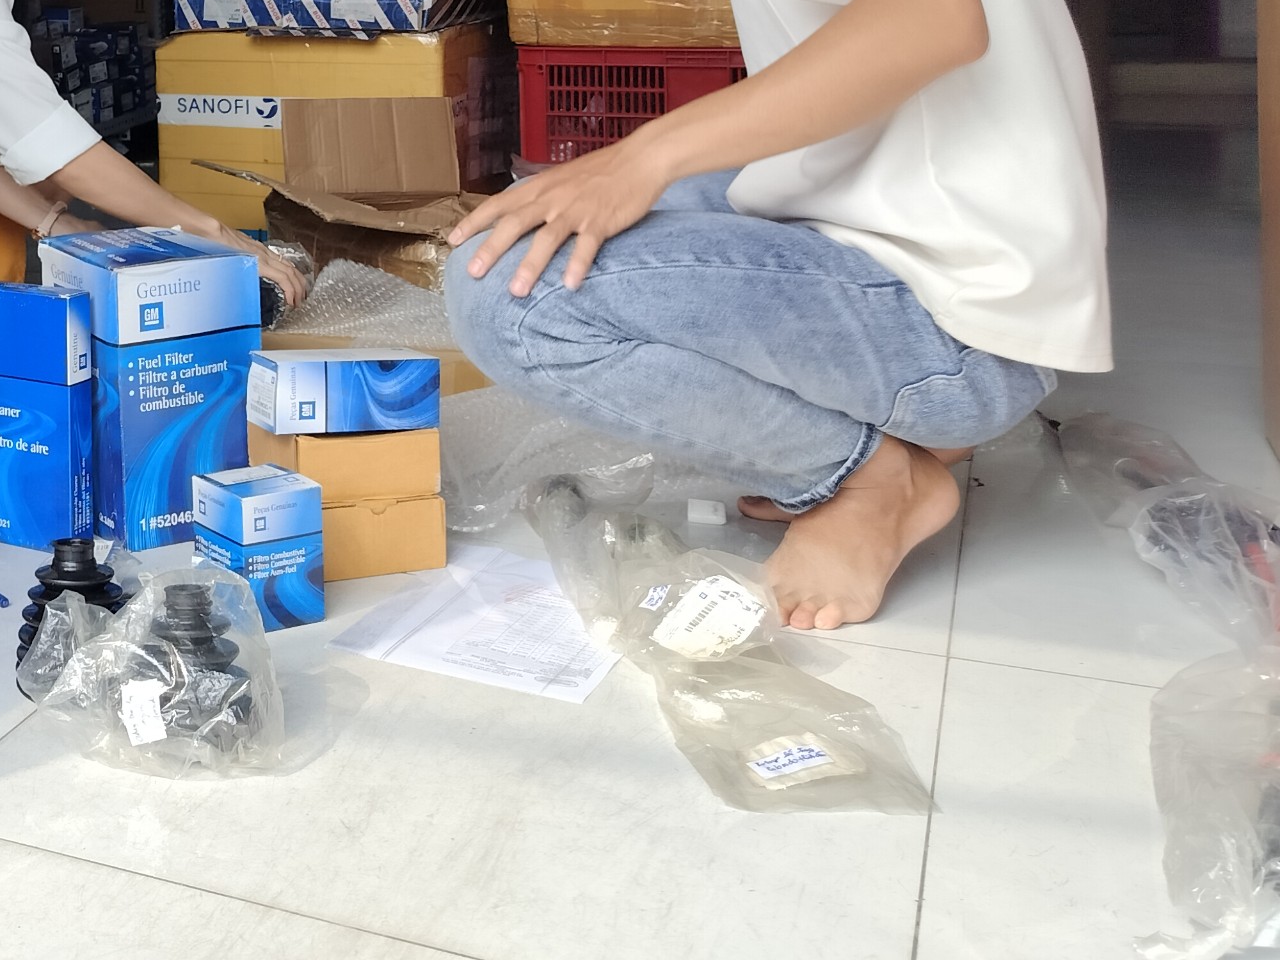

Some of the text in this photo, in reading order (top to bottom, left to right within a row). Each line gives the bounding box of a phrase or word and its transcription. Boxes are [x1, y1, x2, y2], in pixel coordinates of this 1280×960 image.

[177, 98, 250, 115] SANOFI
[50, 264, 85, 289] Genuine
[136, 277, 202, 299] Genuine
[144, 307, 160, 322] GM
[138, 351, 194, 371] Fuel Filter
[138, 371, 168, 385] Filtre
[180, 359, 228, 379] carburant
[139, 381, 186, 400] Filtro de
[140, 392, 205, 413] combustible
[289, 403, 297, 421] Peças
[15, 438, 29, 452] de
[30, 441, 50, 456] aire
[253, 505, 270, 515] Peças
[140, 519, 147, 531] 1
[253, 554, 270, 564] Filtro
[253, 556, 306, 572] Filtro Combustible
[253, 570, 270, 580] Filter
